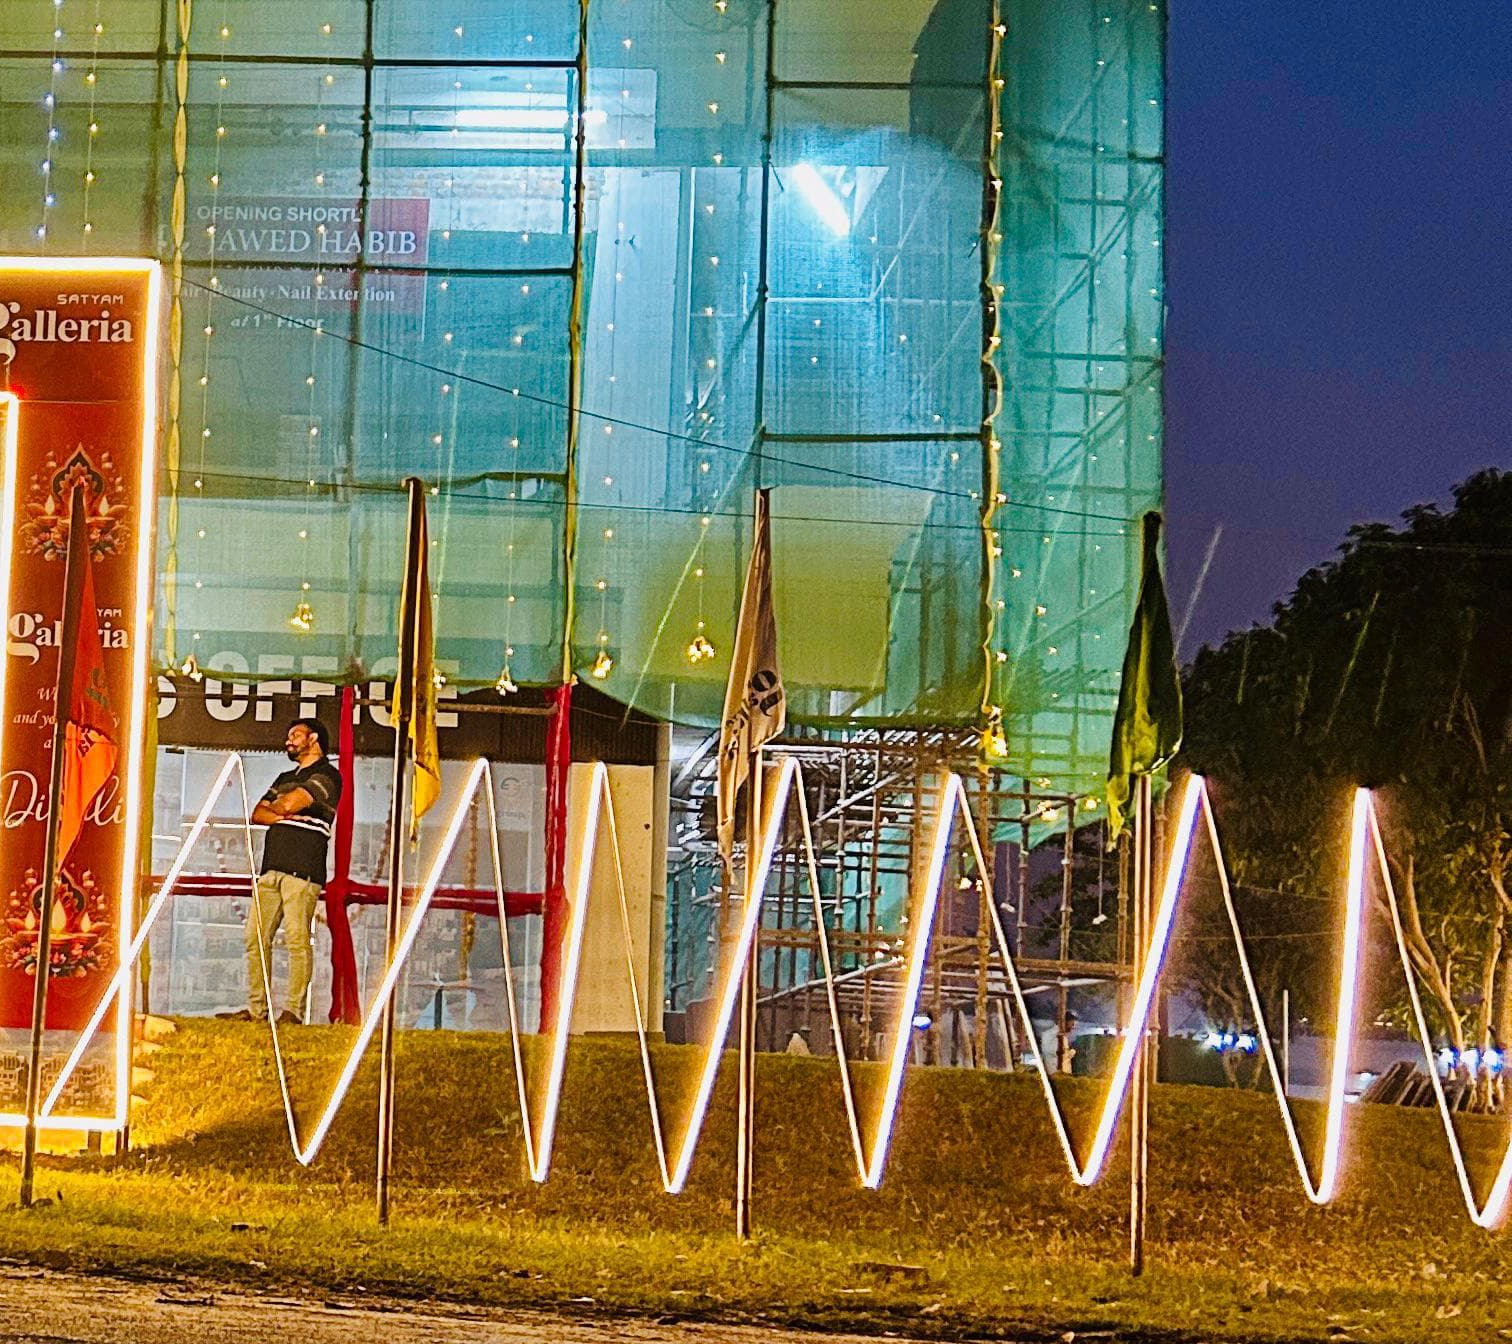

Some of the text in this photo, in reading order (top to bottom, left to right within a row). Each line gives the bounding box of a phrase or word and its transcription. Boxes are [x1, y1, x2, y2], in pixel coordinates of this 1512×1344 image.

[197, 206, 363, 223] OPENING SHORTL
[320, 230, 416, 254] HABIB
[56, 294, 124, 305] SATYAM
[277, 285, 311, 301] Nail
[13, 710, 40, 725] and
